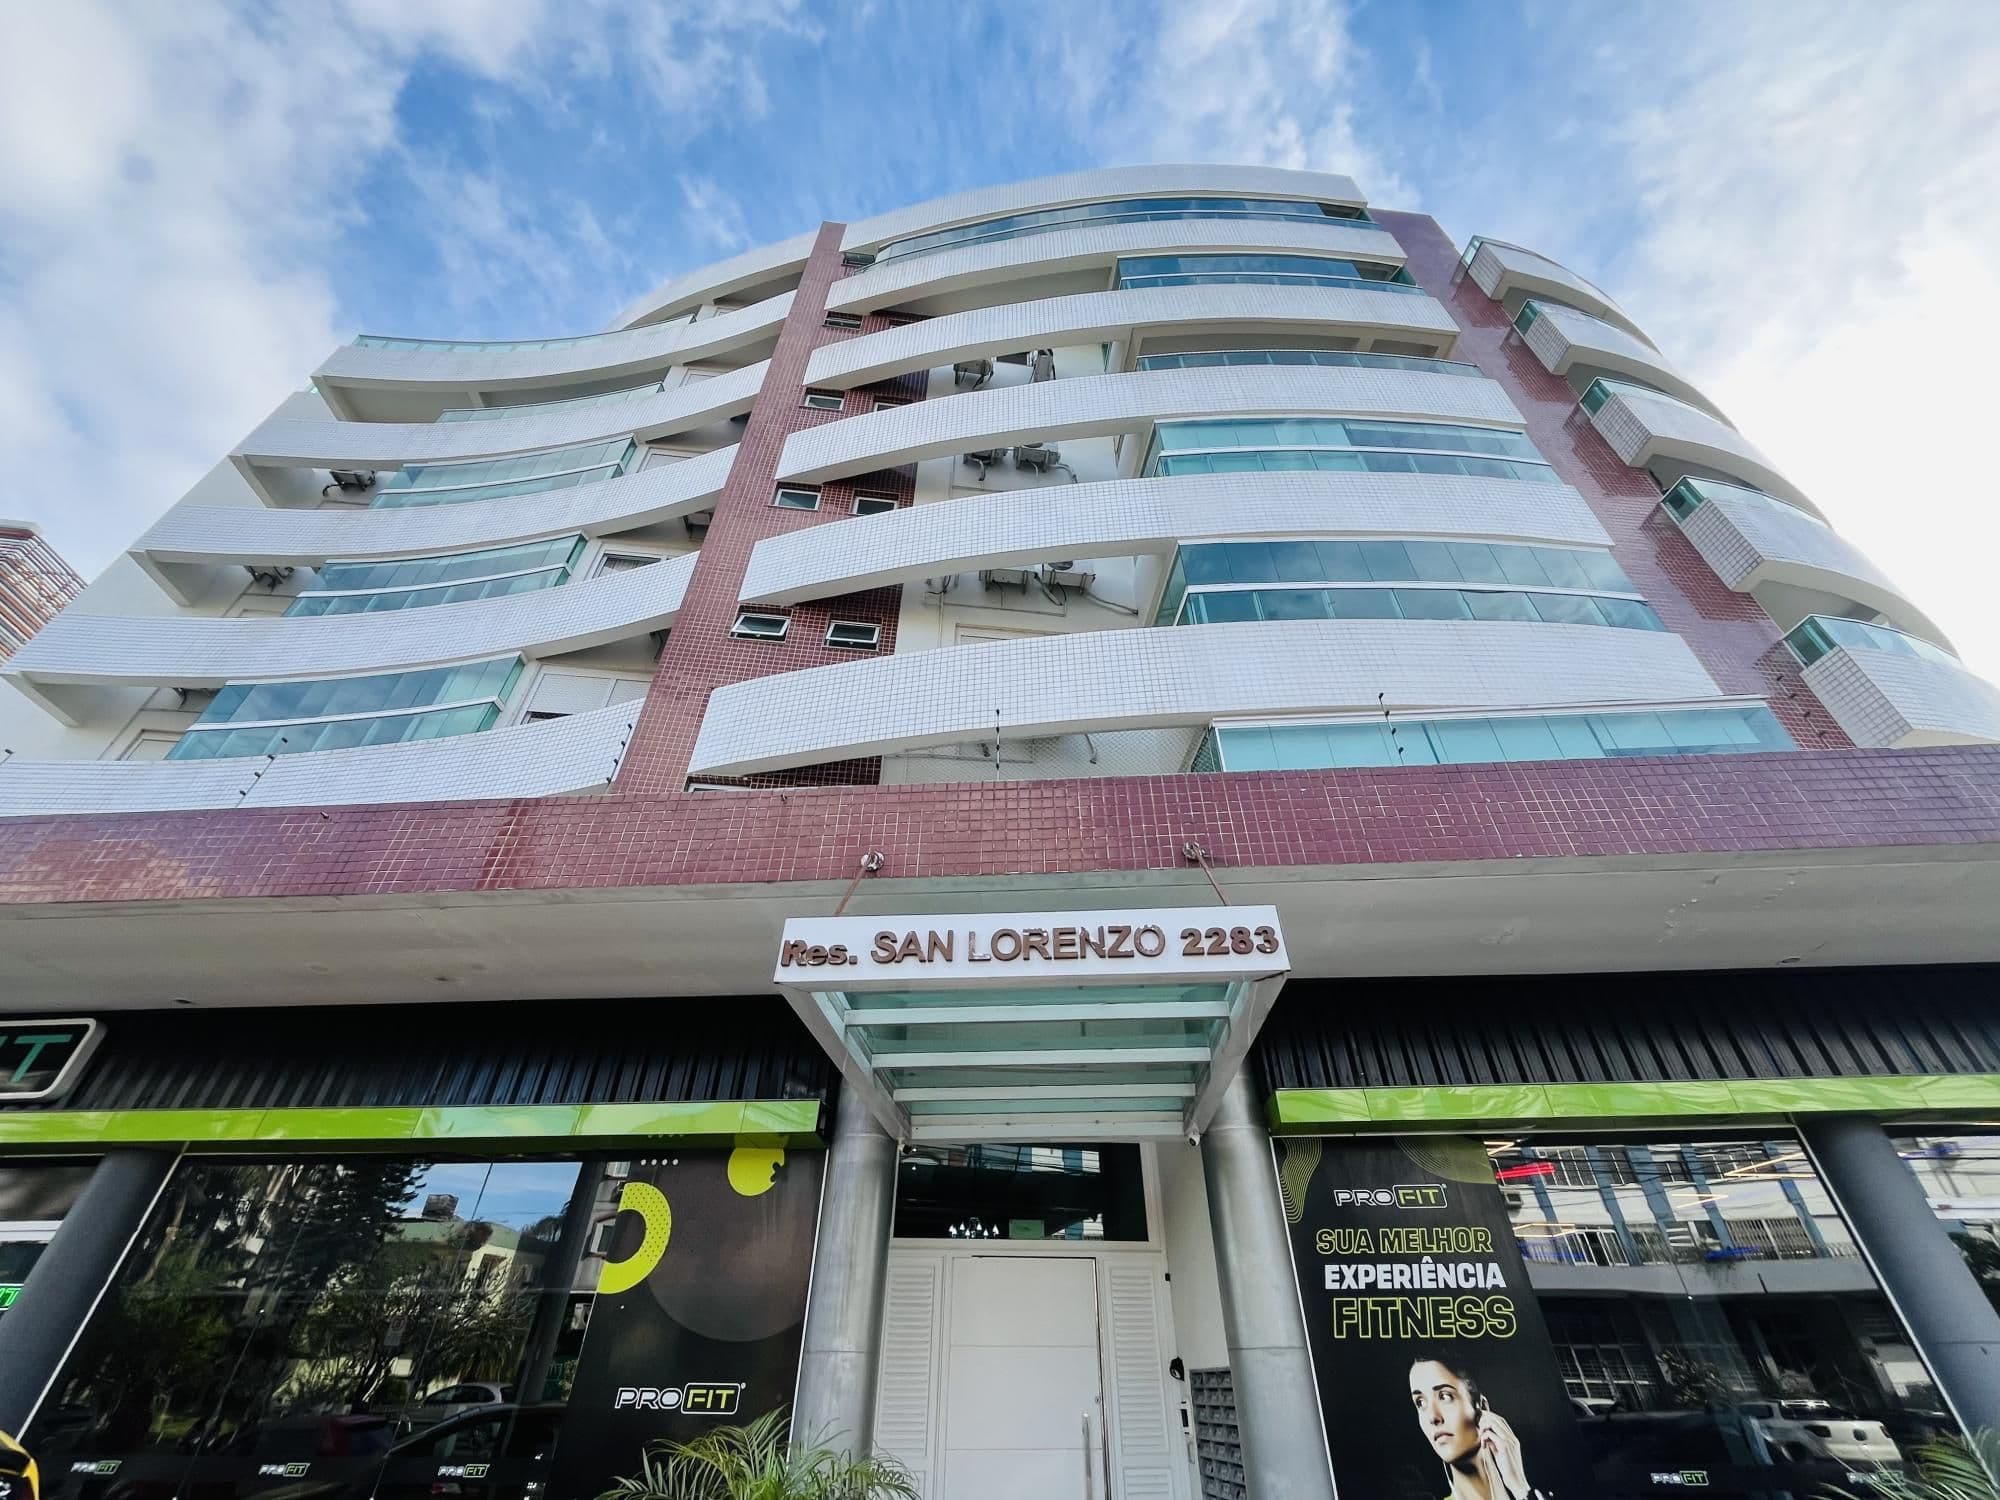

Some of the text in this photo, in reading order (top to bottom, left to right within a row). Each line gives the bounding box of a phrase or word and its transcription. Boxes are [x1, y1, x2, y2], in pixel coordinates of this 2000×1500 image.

[781, 924, 1280, 967] Res. SAN LORENZO 2283
[0, 1034, 73, 1084] T
[1316, 1226, 1494, 1255] SUA MELHOR
[1324, 1255, 1507, 1290] EXPERIÊNCIA
[1333, 1296, 1517, 1339] FITNESS
